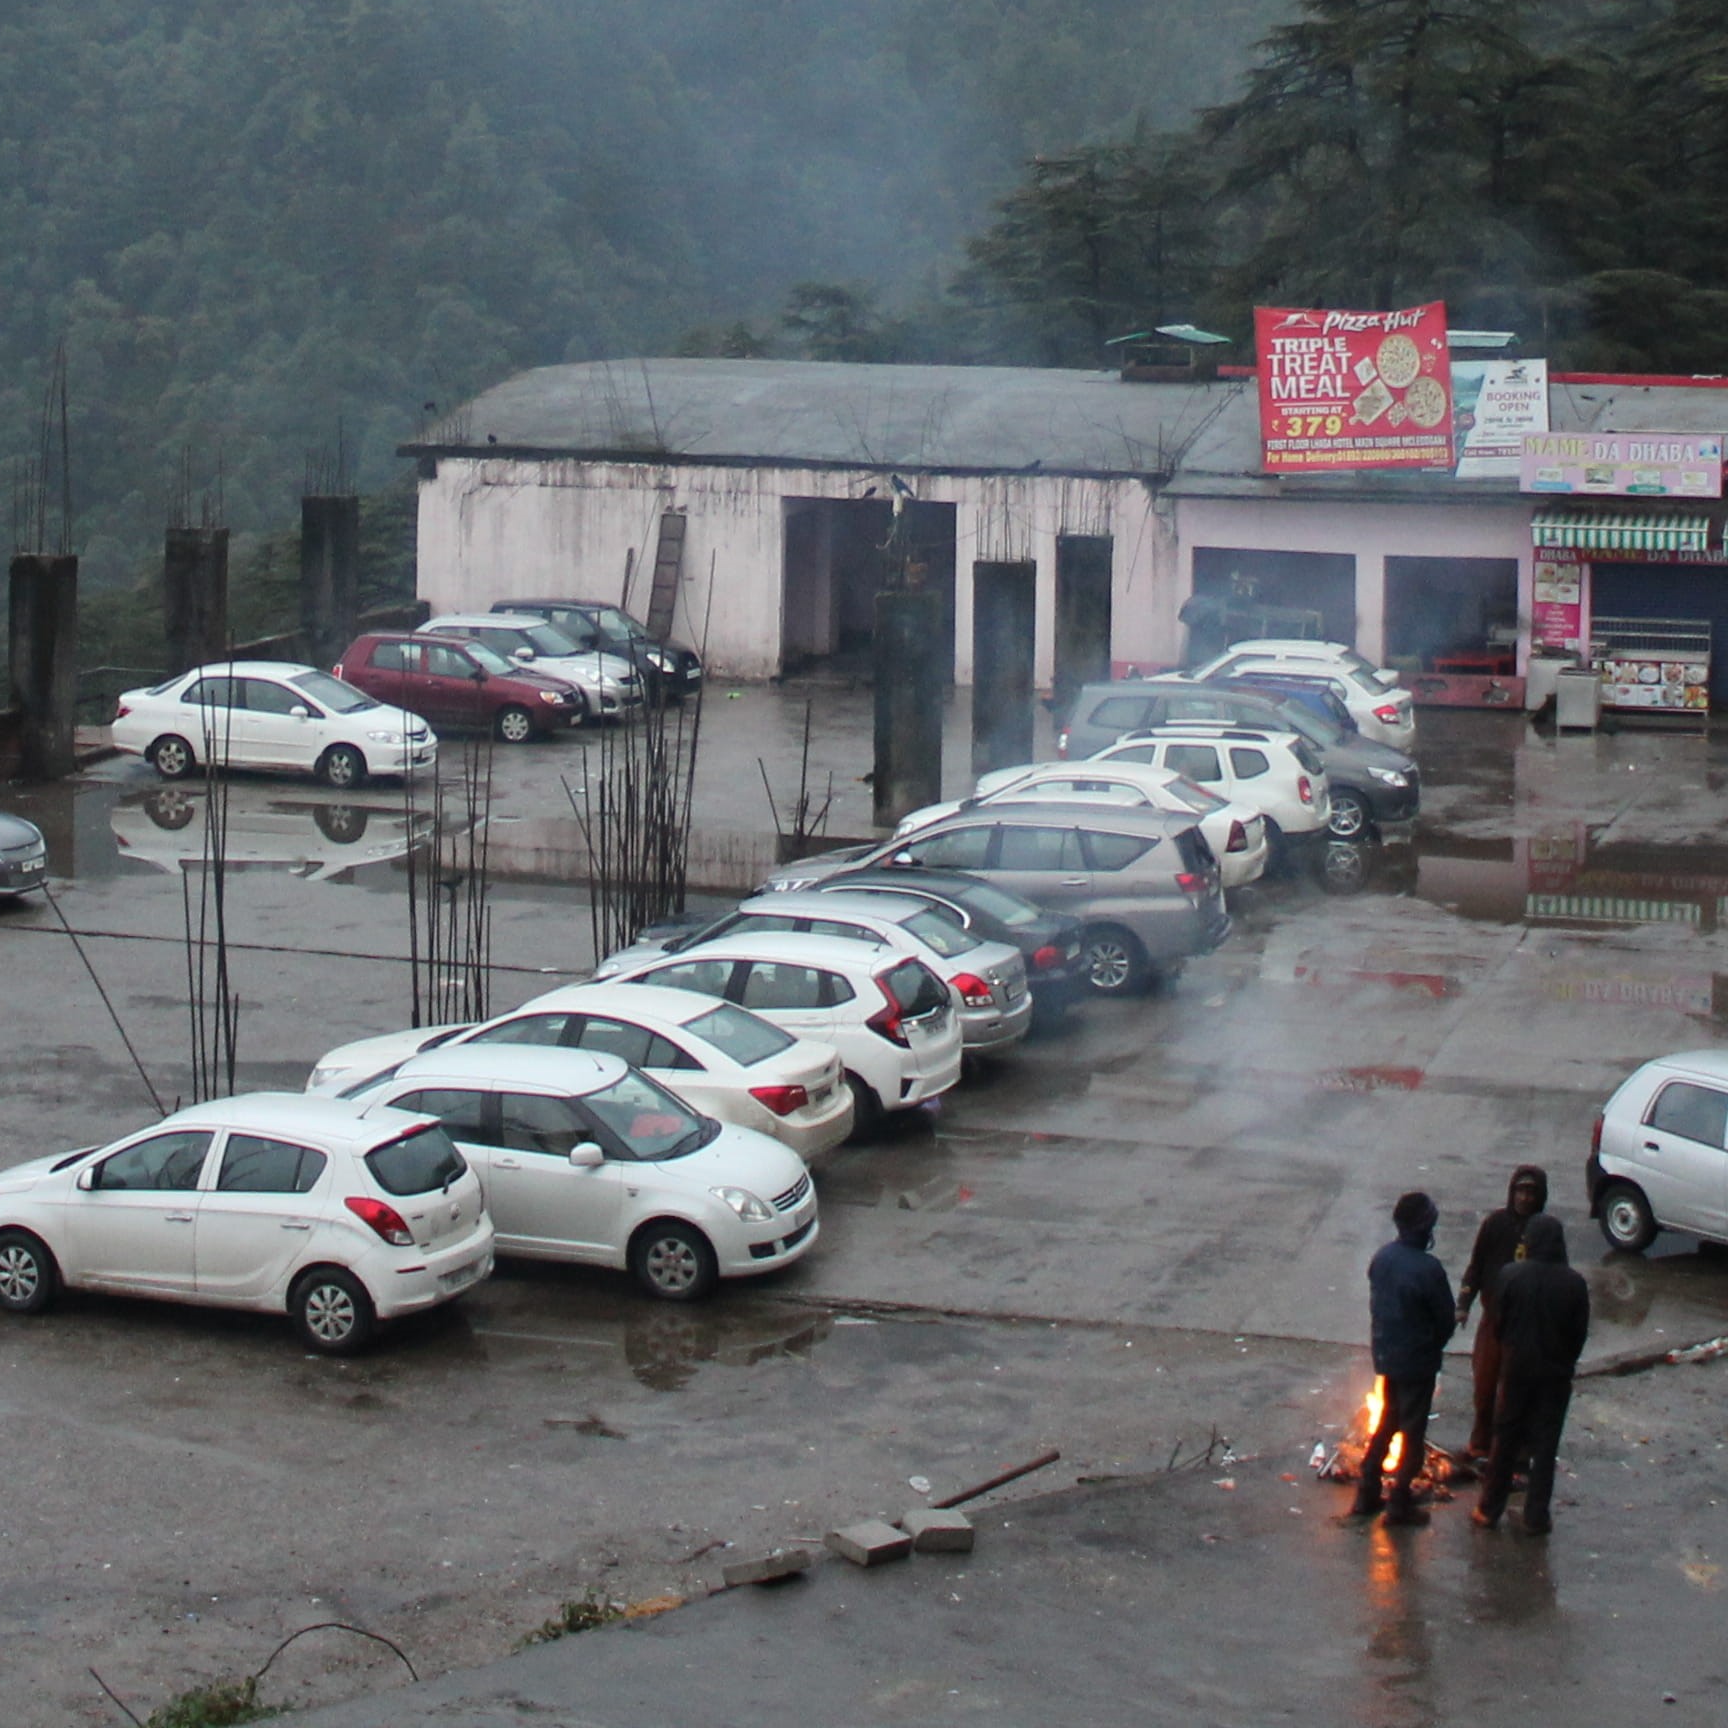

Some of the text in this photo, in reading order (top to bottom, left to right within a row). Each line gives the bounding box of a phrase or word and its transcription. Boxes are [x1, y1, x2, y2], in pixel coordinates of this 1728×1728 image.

[1322, 308, 1426, 335] Pizza Hut
[1272, 336, 1347, 353] TRIPLE
[1267, 352, 1352, 376] TREAT
[1271, 375, 1351, 399] MEAL
[1486, 391, 1541, 402] BOOKING
[1281, 406, 1330, 416] STARTING
[1498, 402, 1529, 411] OPEN
[1286, 416, 1343, 437] 379
[1594, 441, 1620, 460] DA
[1629, 442, 1695, 463] DHABA
